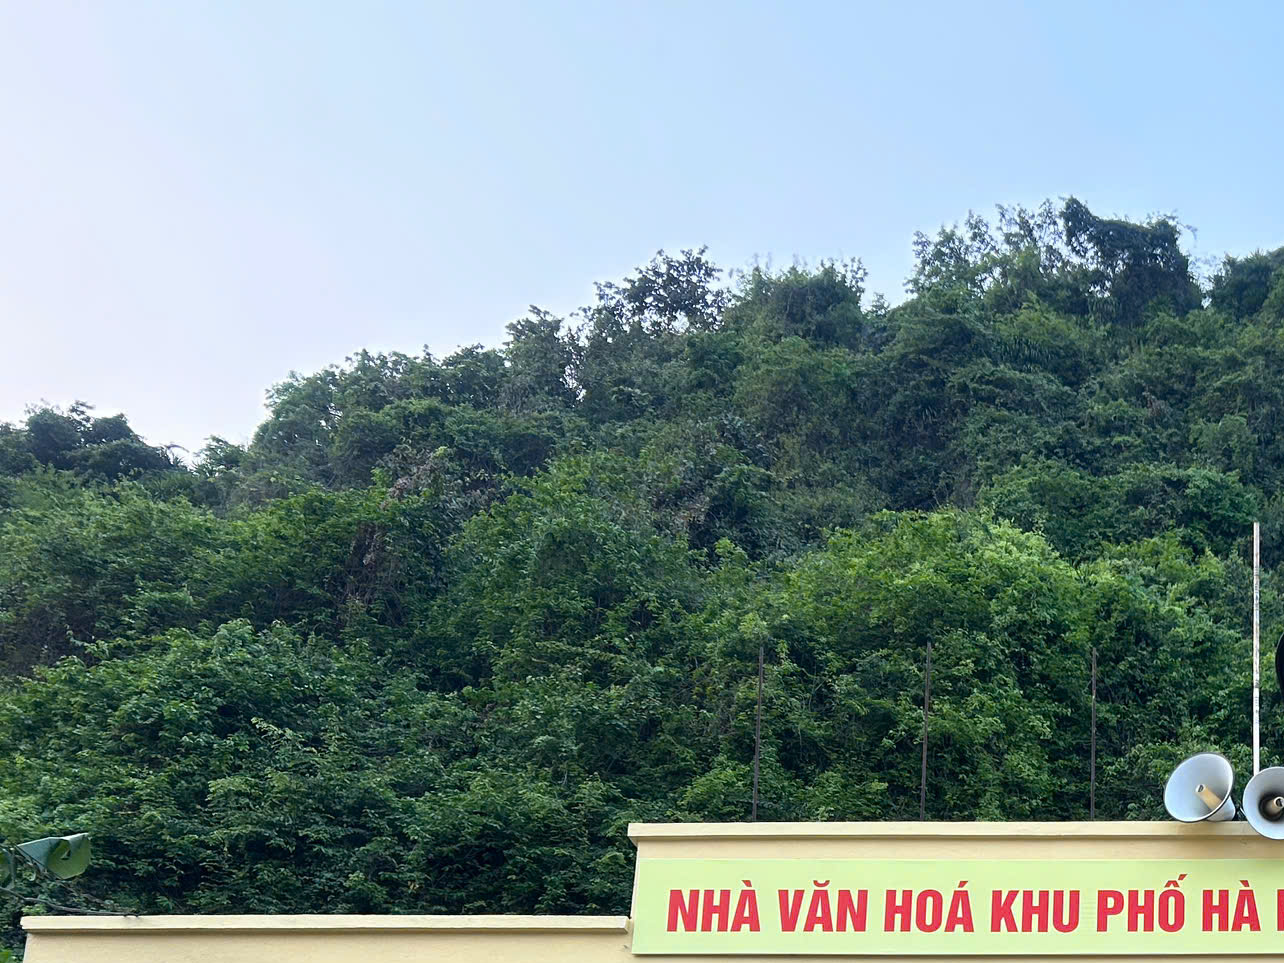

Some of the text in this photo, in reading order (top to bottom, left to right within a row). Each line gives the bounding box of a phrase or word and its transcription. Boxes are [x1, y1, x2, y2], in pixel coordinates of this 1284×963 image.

[668, 880, 760, 932] NHÀ
[777, 880, 869, 933] VĂN
[884, 880, 975, 933] HOÁ
[992, 889, 1081, 933] KHU
[1097, 873, 1187, 933] PHỐ
[1201, 879, 1261, 932] HÀ
